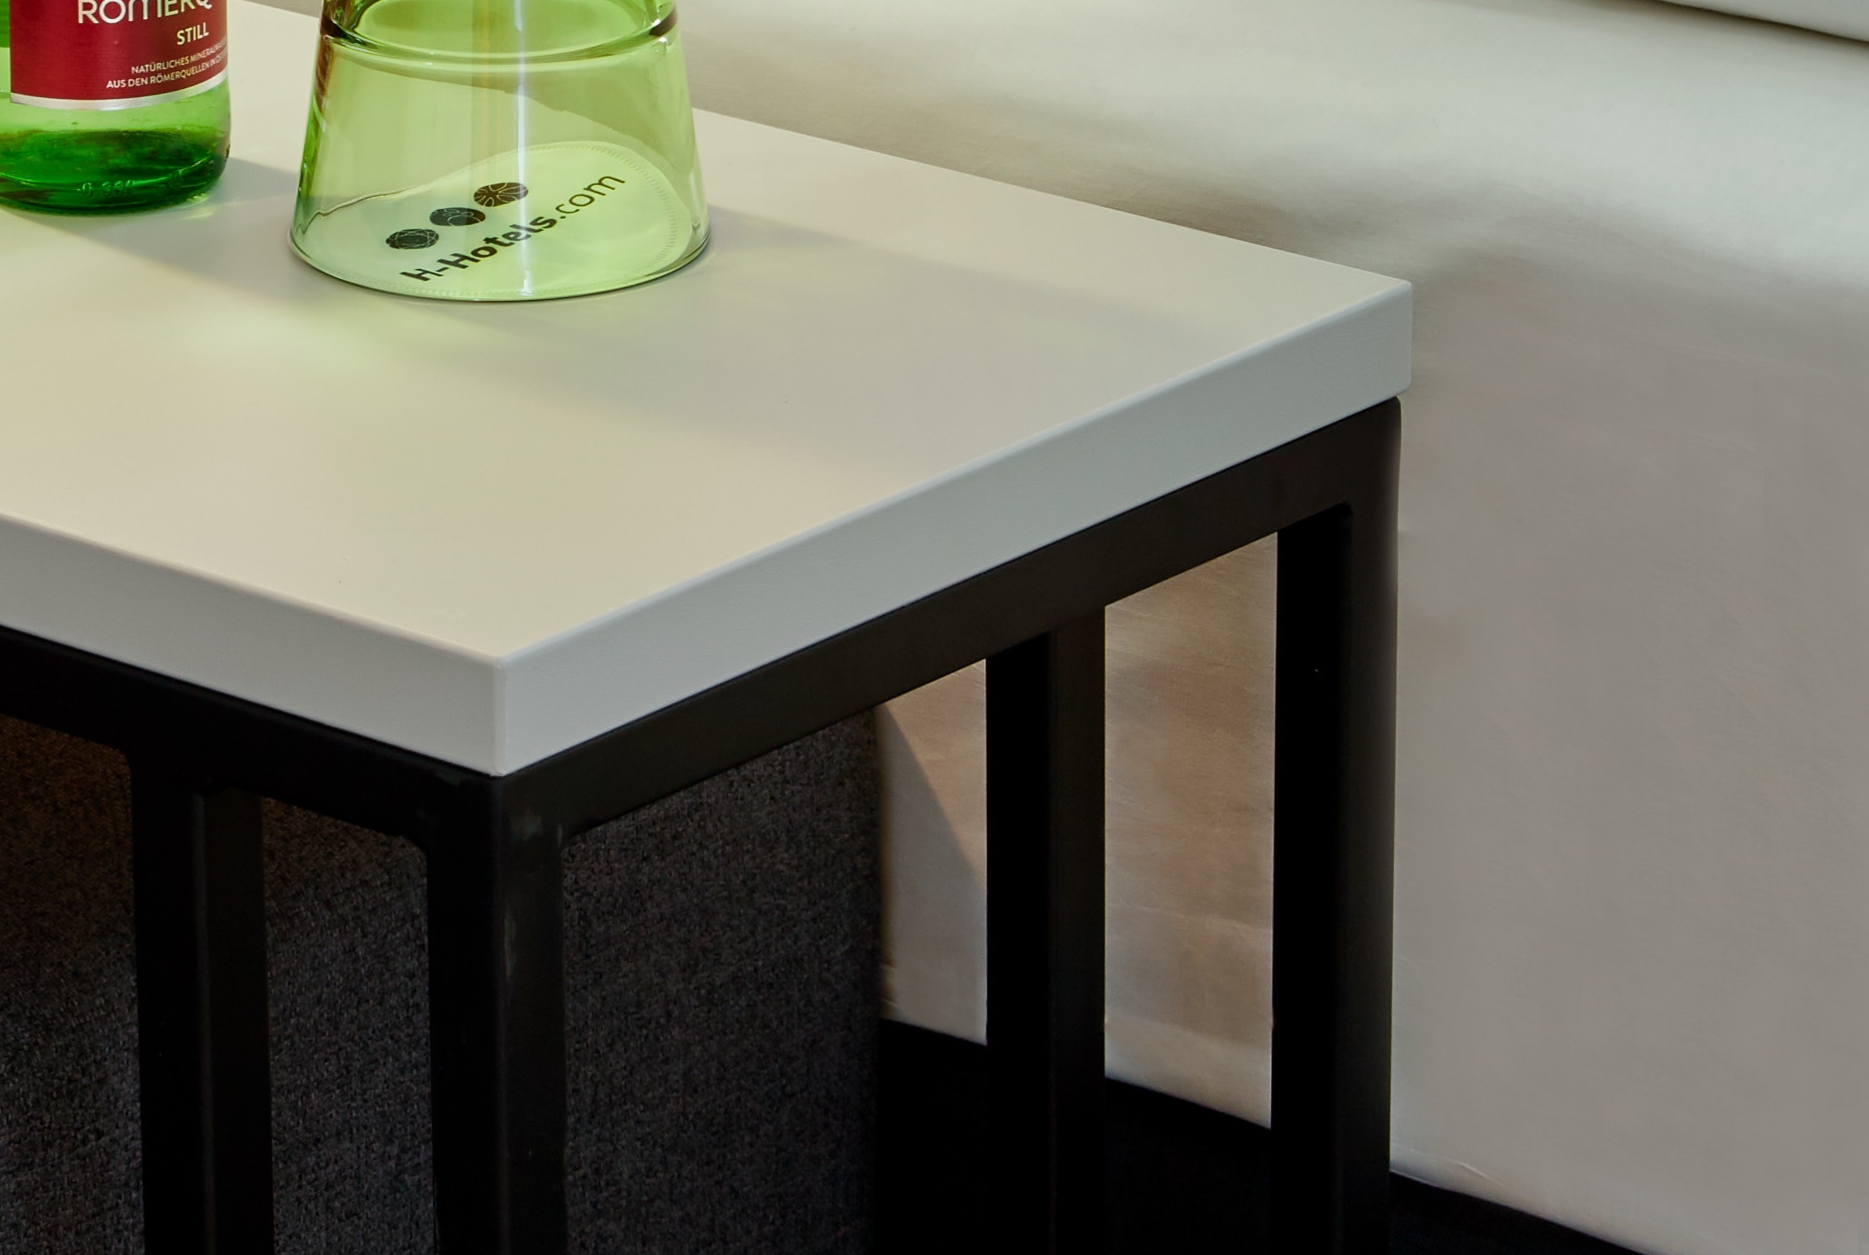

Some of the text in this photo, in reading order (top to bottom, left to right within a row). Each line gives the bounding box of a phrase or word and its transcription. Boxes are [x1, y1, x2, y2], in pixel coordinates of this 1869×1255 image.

[176, 22, 209, 45] STILL
[131, 55, 189, 74] NATÜRLICHES
[106, 79, 126, 89] AUS
[127, 77, 148, 87] DEN
[400, 175, 626, 281] H-Hotels.com
